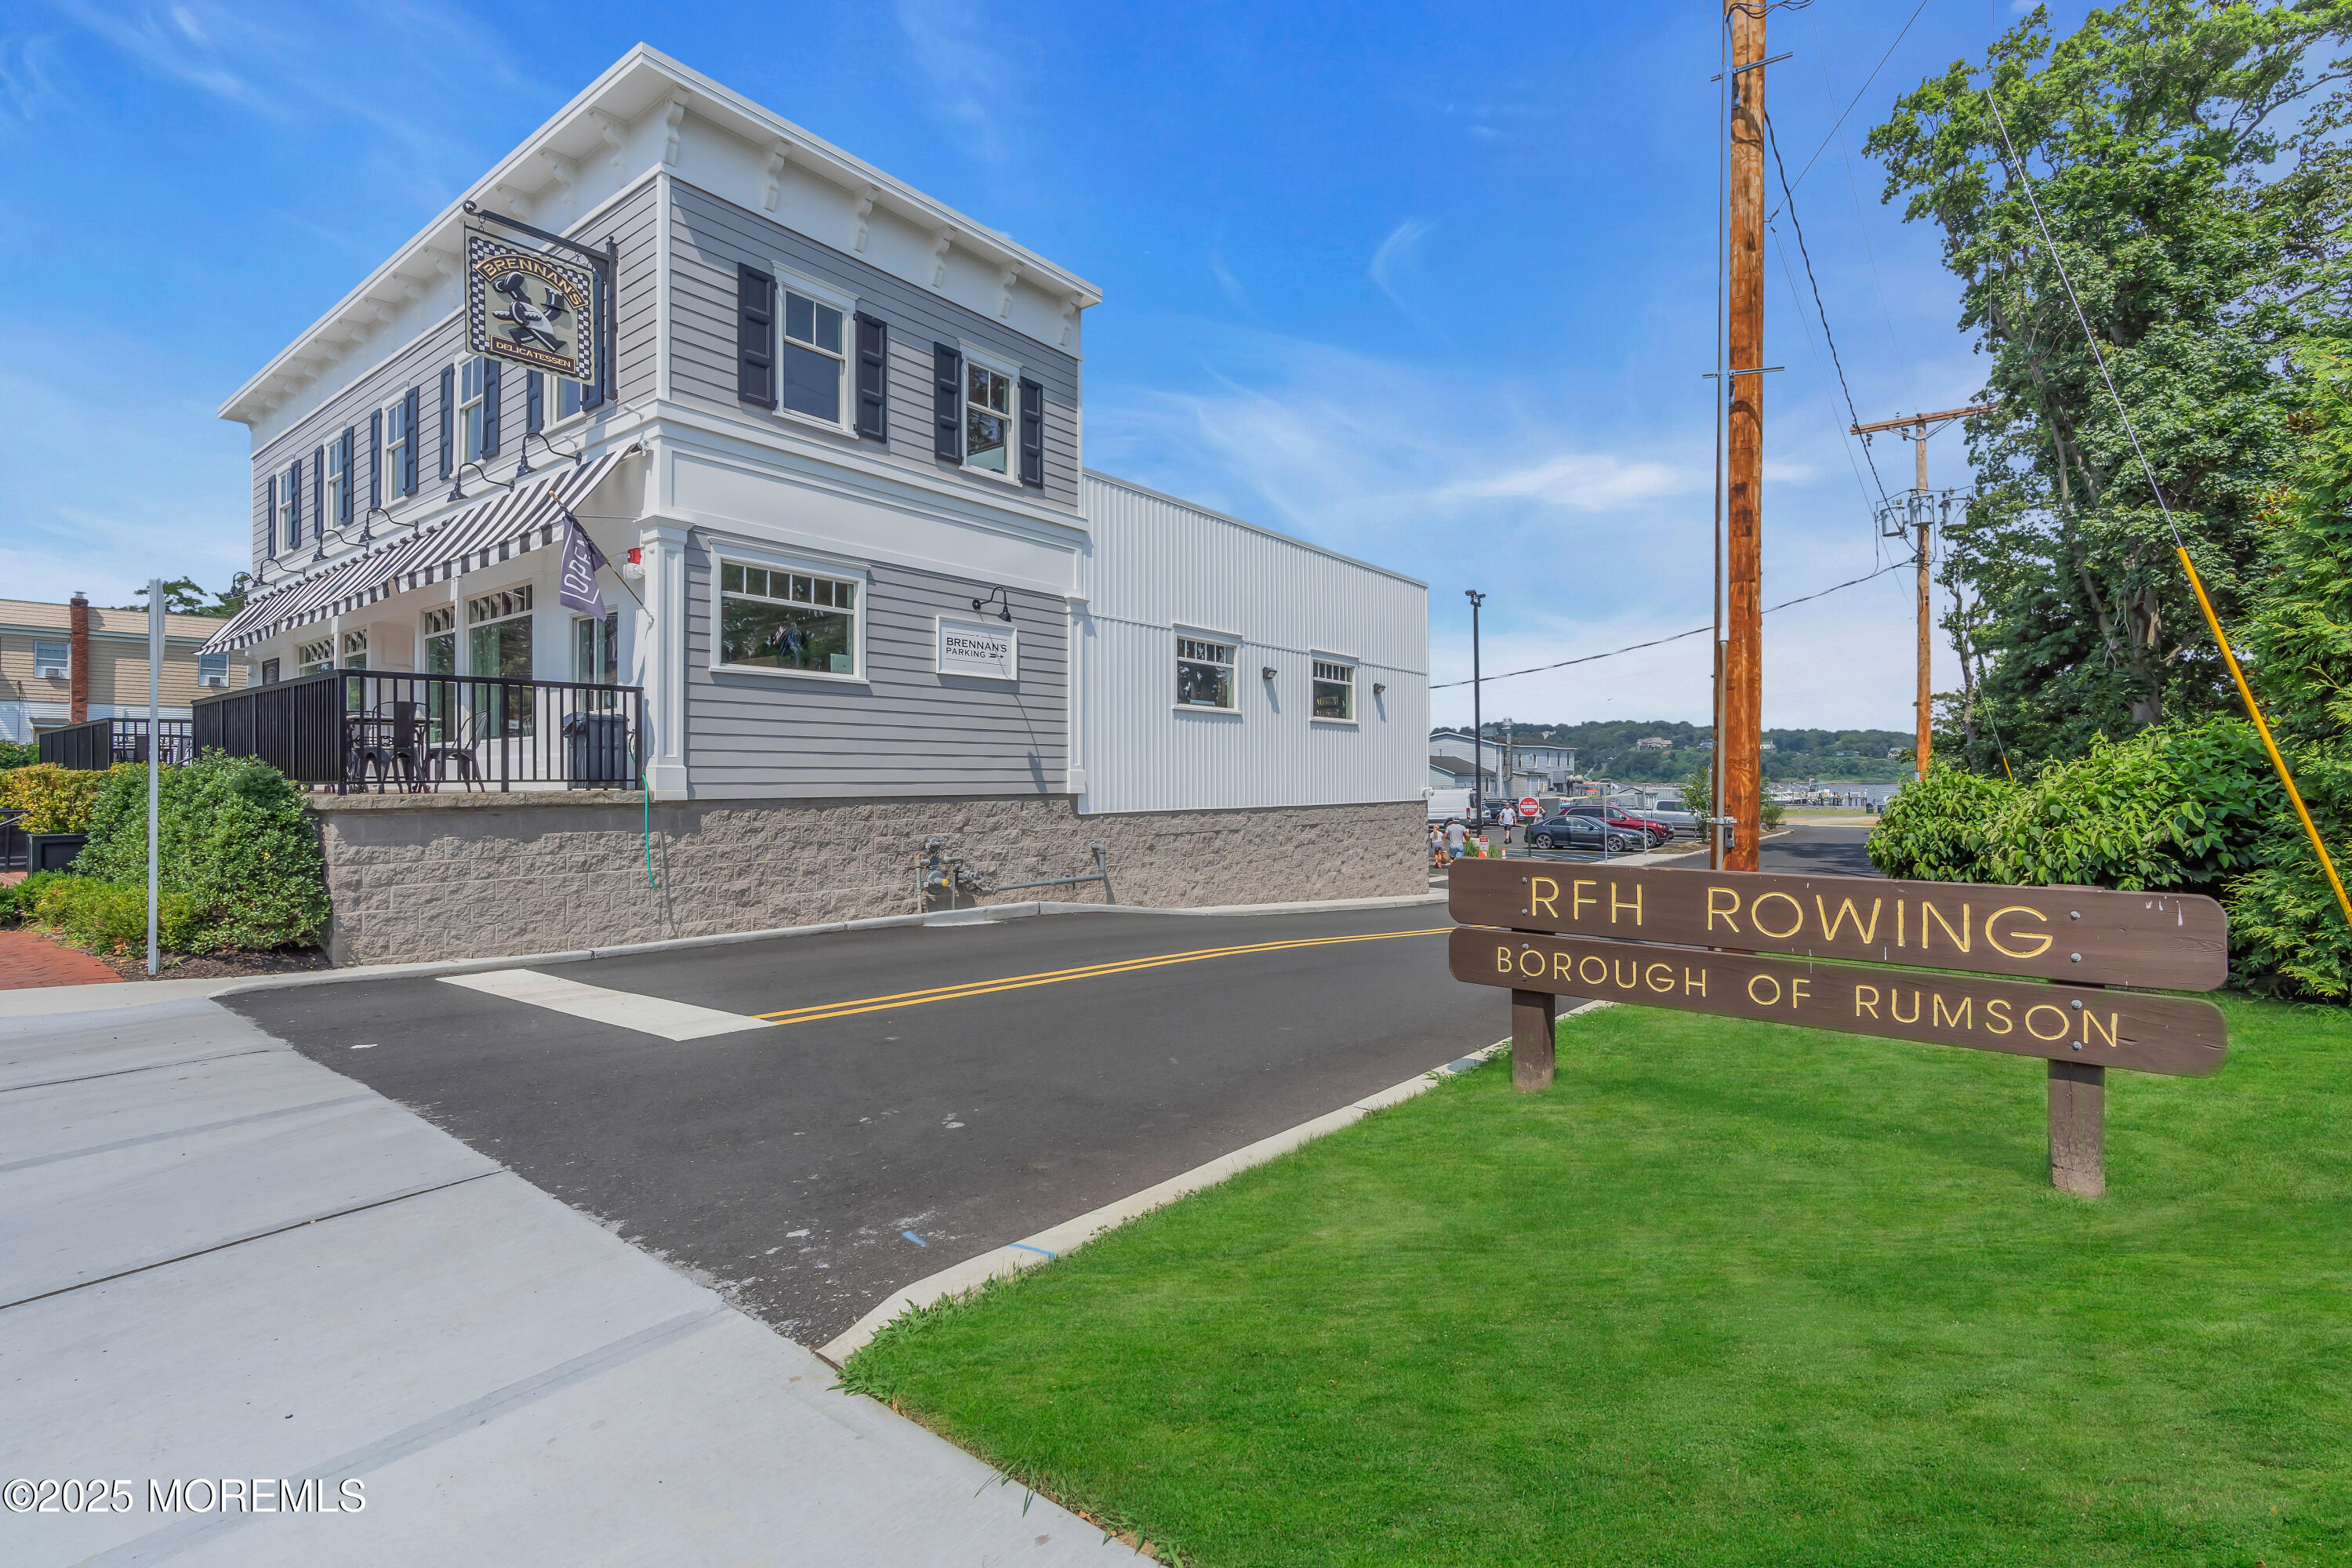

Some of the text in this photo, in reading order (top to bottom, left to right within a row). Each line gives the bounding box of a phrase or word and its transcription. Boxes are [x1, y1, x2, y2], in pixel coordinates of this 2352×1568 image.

[482, 257, 583, 305] BRENNAN'S
[495, 340, 572, 368] DELICATESSEN
[946, 637, 1007, 652] BRENNAN'S
[946, 647, 985, 658] PARKING
[1530, 875, 2055, 959] RFH ROWING
[1496, 945, 2119, 1047] BOROUGH OF RUMSON
